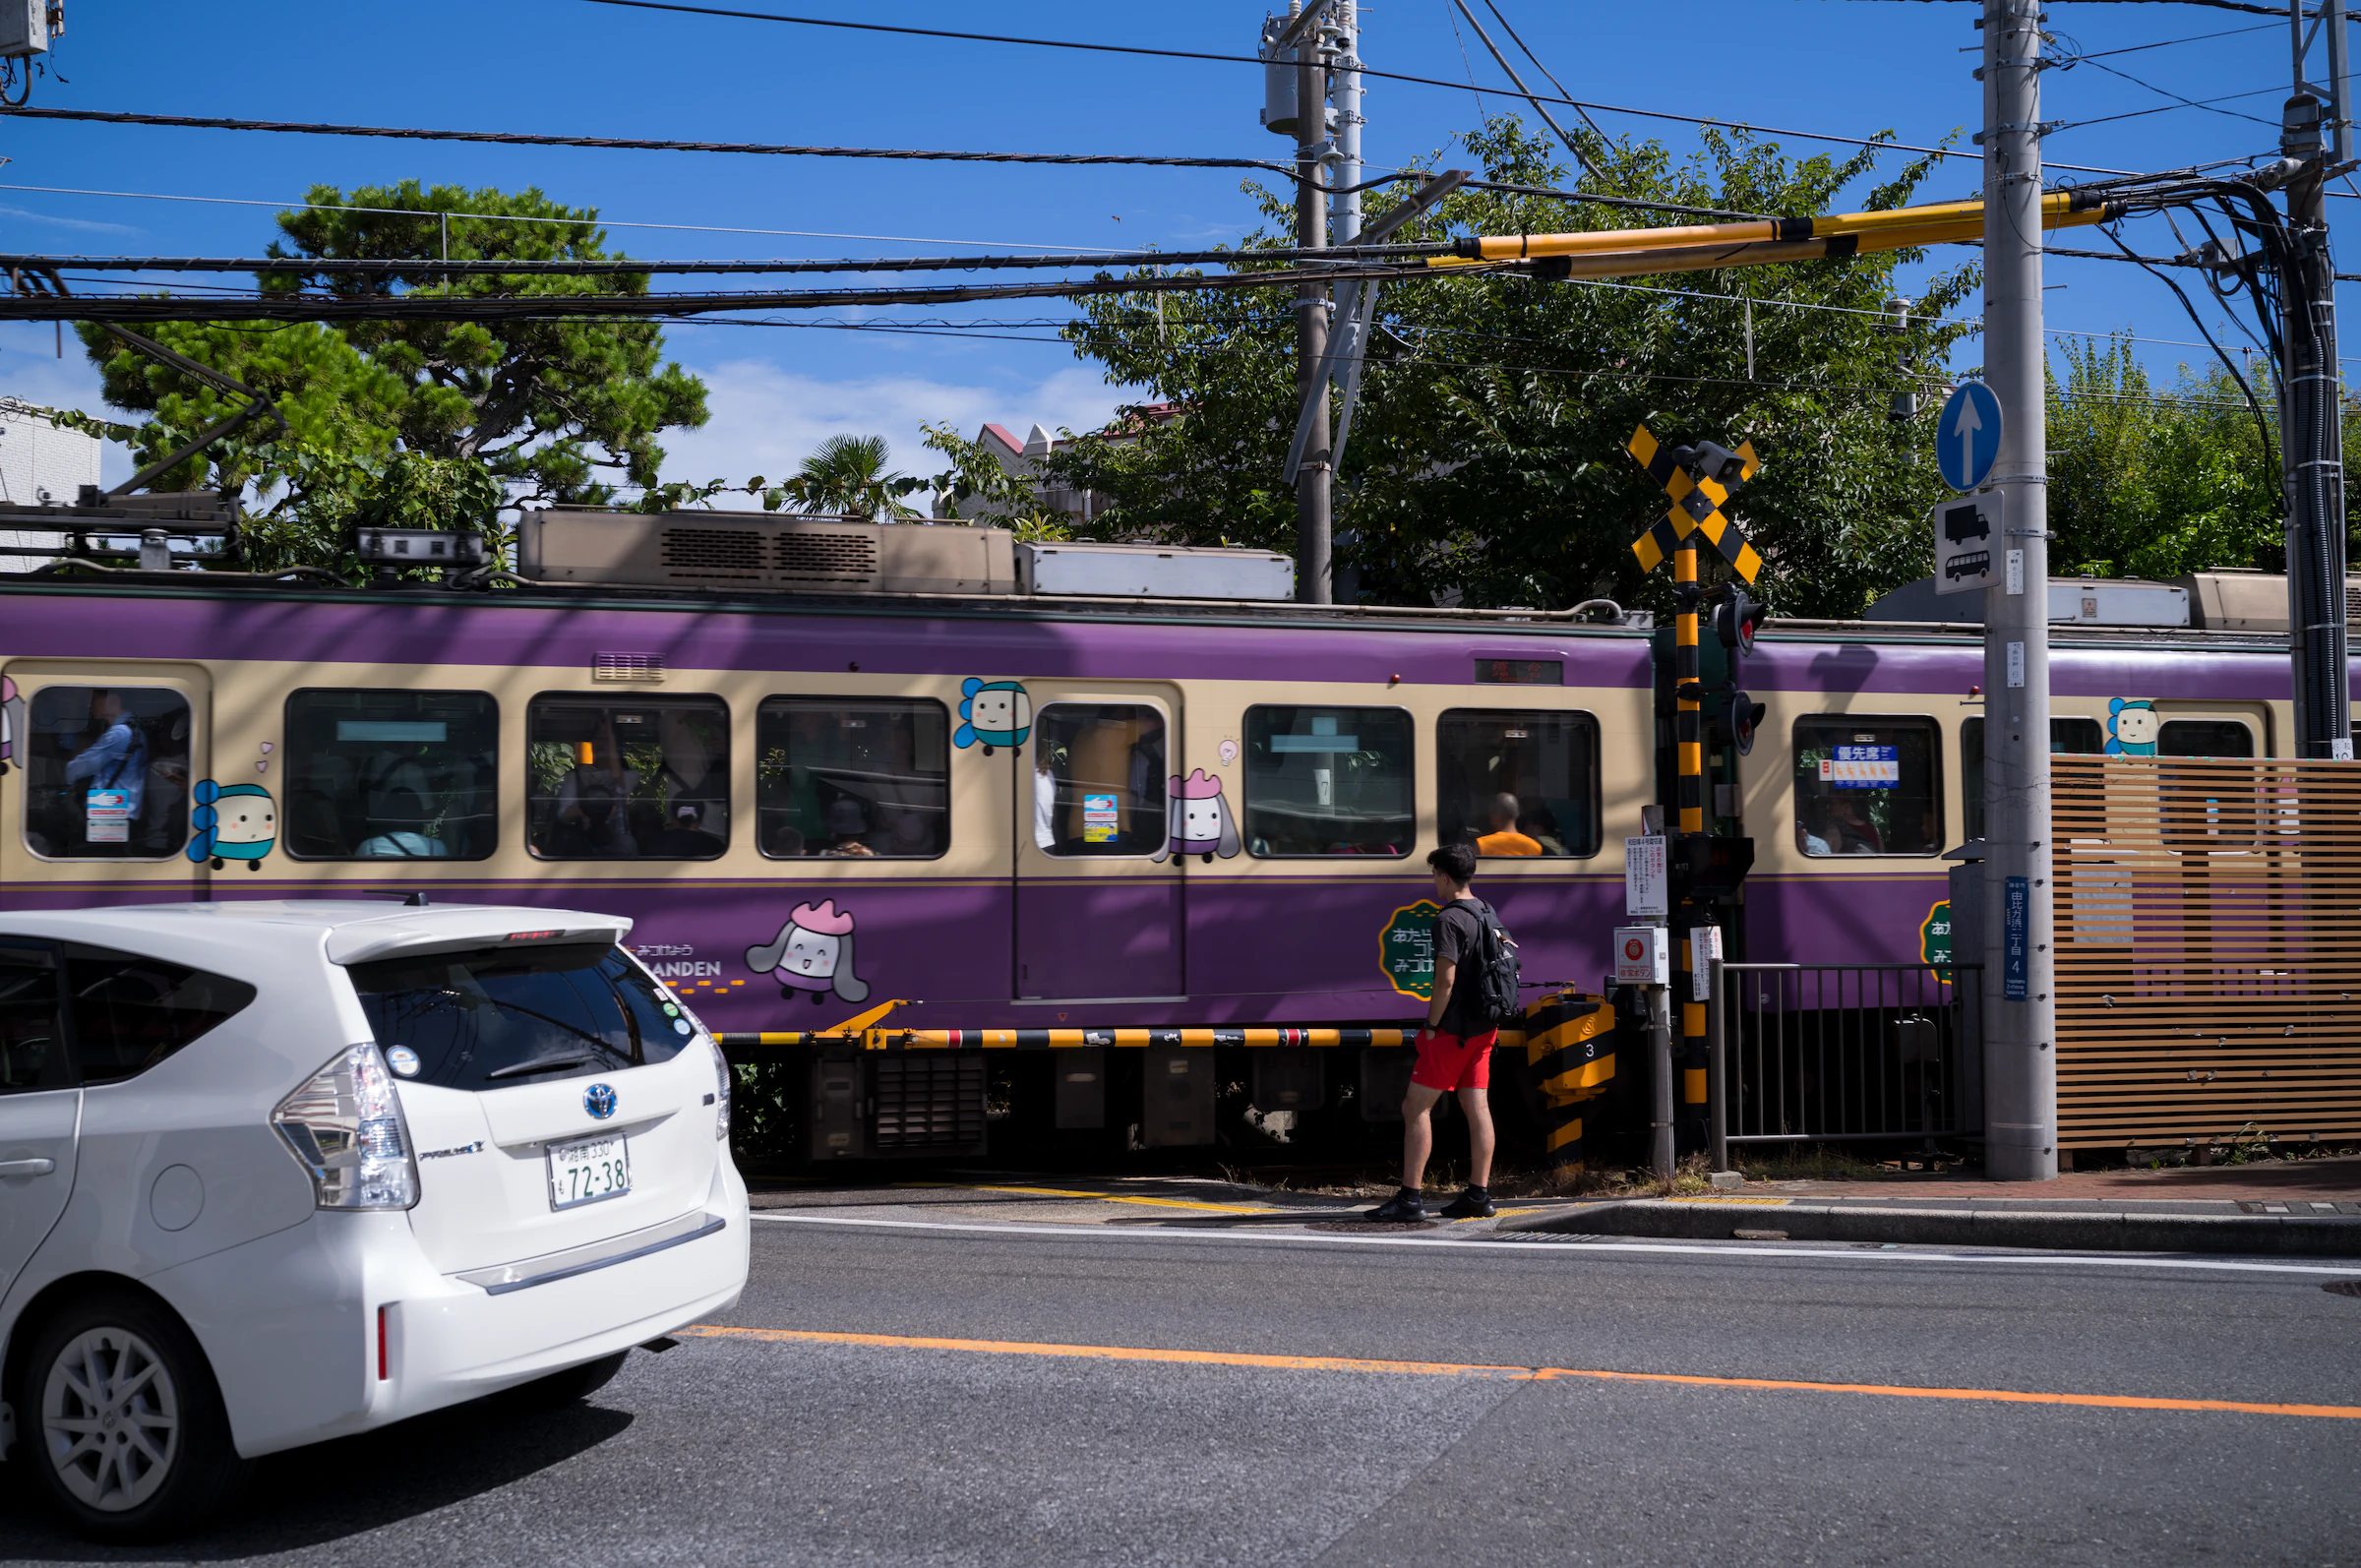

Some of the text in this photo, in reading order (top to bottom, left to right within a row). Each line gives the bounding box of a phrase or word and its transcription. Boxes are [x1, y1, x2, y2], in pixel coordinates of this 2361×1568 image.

[1838, 747, 1880, 760] 優先席
[636, 943, 695, 957] みつけよう
[1620, 969, 1652, 978] 非常ボタン
[2012, 960, 2021, 974] 4
[1586, 1044, 1595, 1057] 3
[569, 1140, 610, 1163] 湘南 330
[568, 1159, 625, 1201] 72-38
